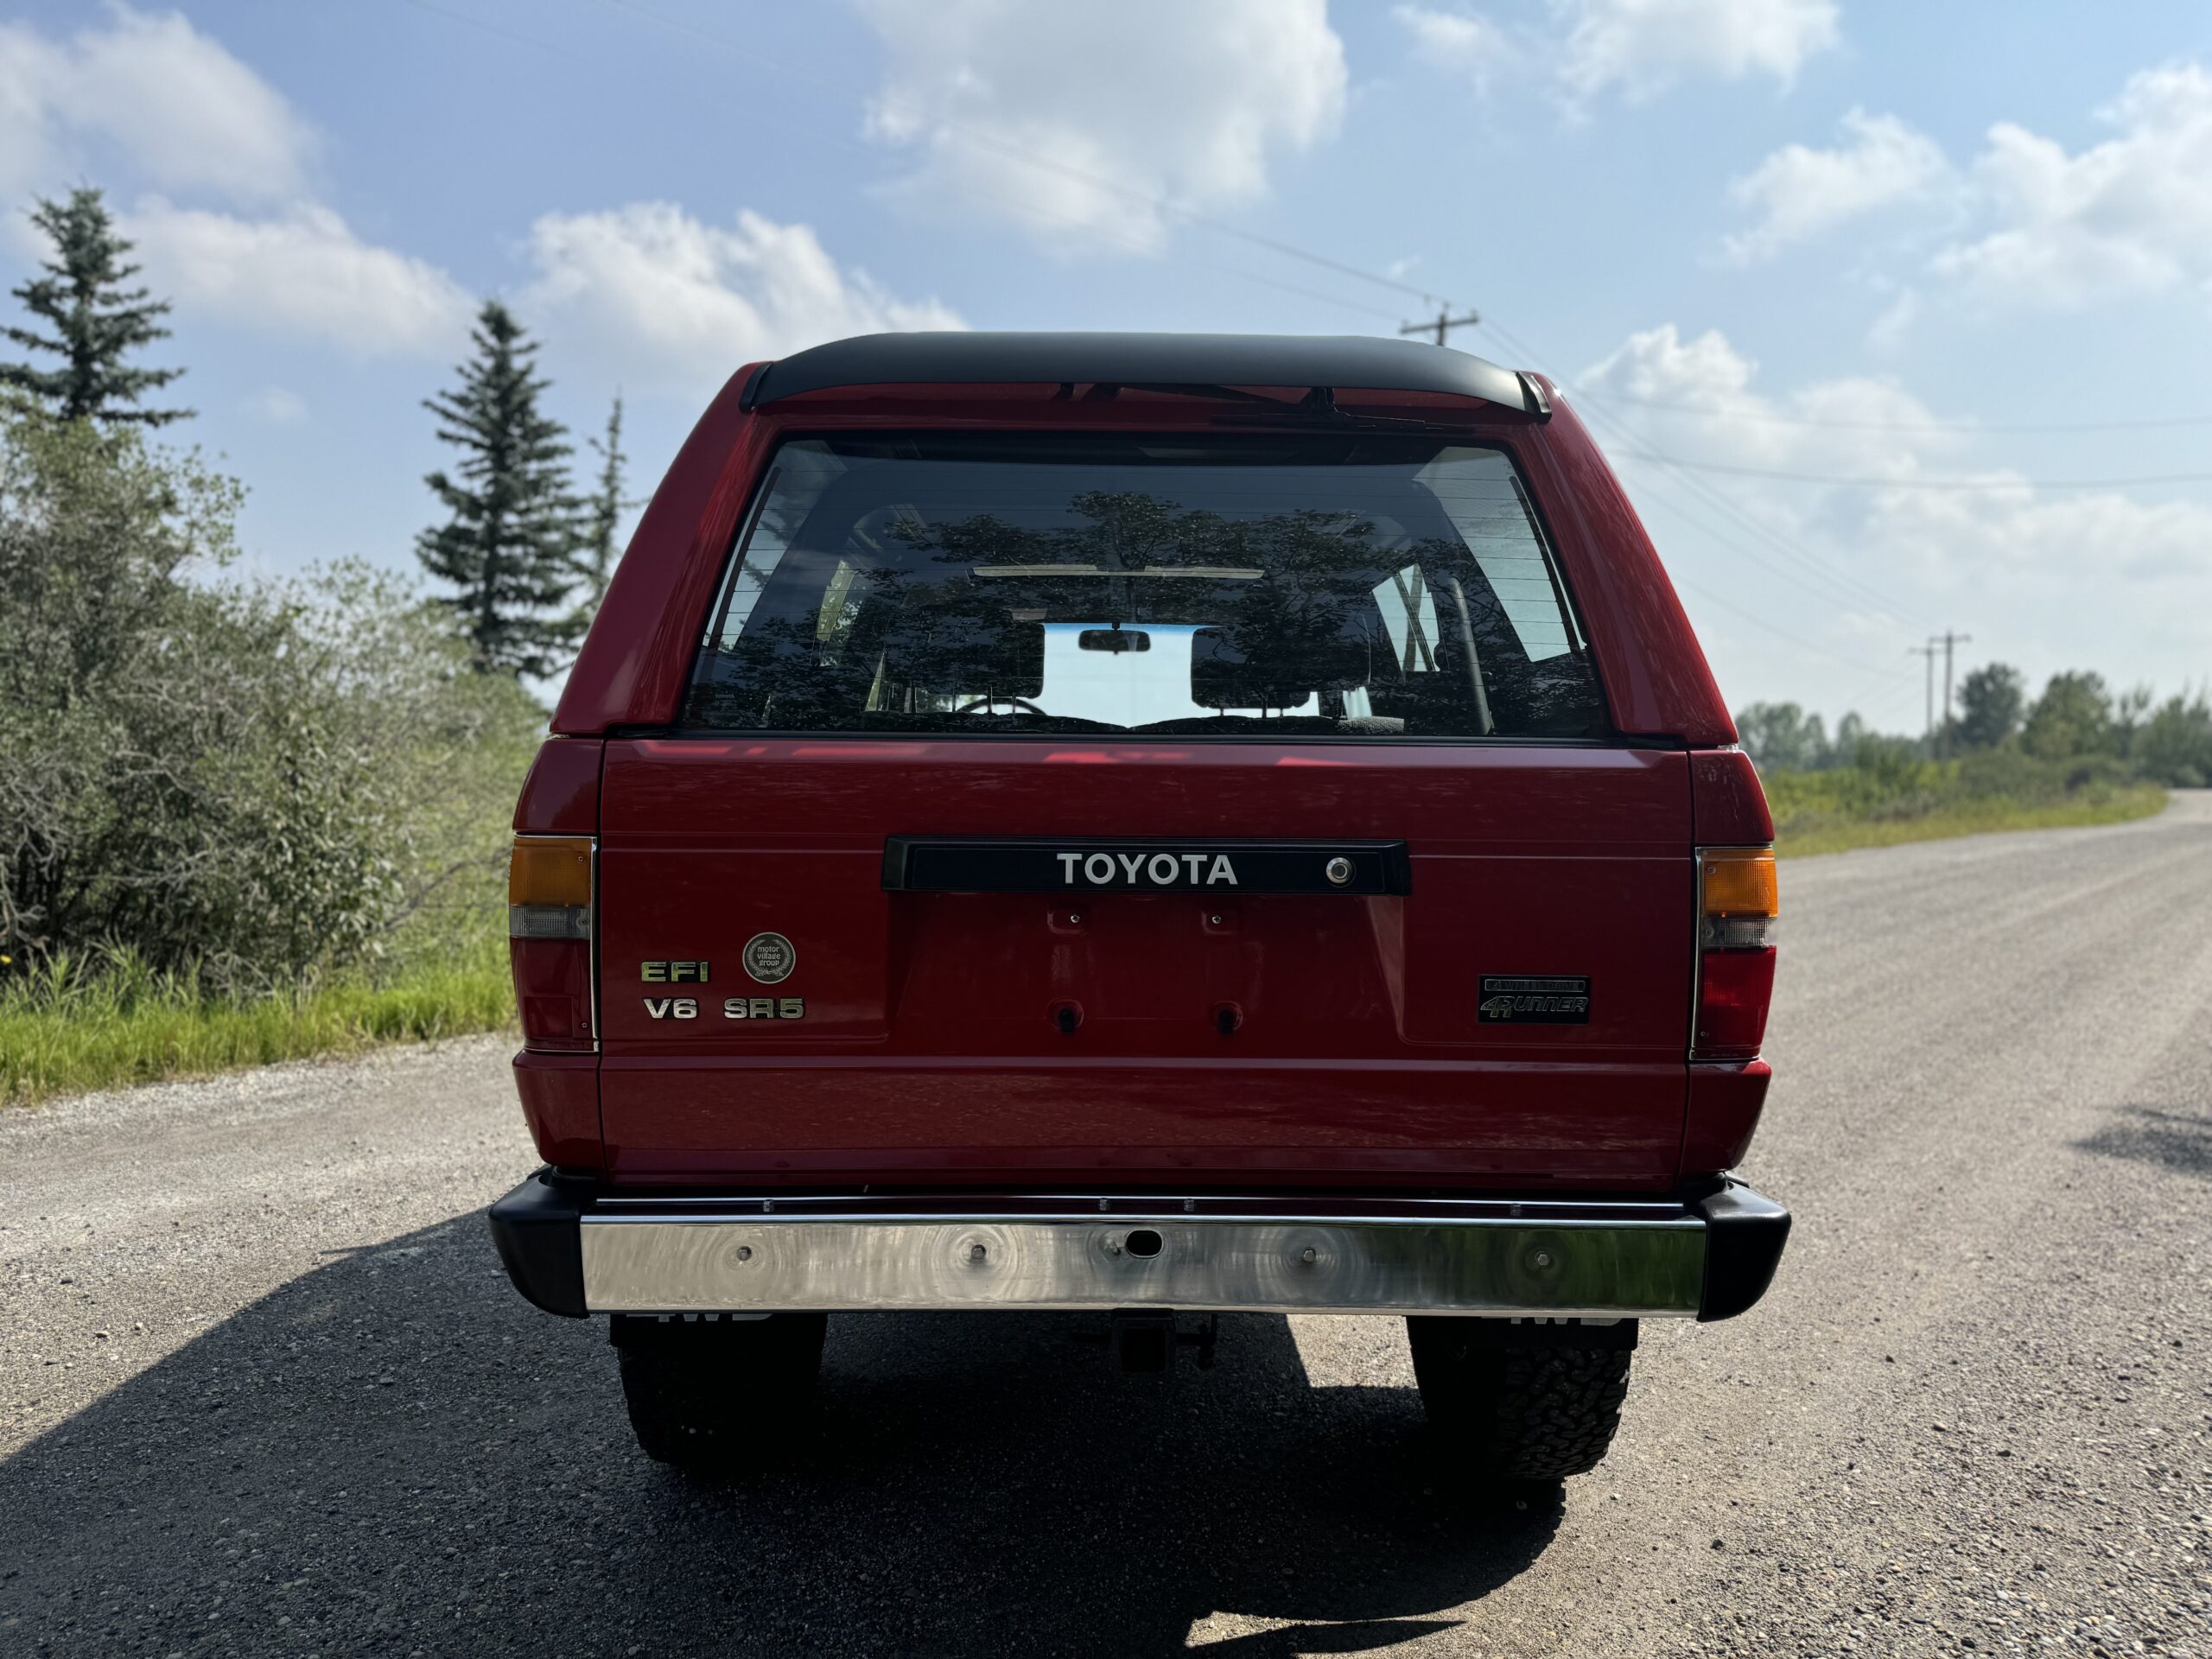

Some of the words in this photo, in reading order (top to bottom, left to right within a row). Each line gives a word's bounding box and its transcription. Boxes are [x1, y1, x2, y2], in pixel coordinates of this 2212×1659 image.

[1057, 853, 1238, 885] TOYOTA
[641, 962, 709, 982] EFI
[643, 998, 697, 1019] V6
[724, 998, 804, 1019] SR5
